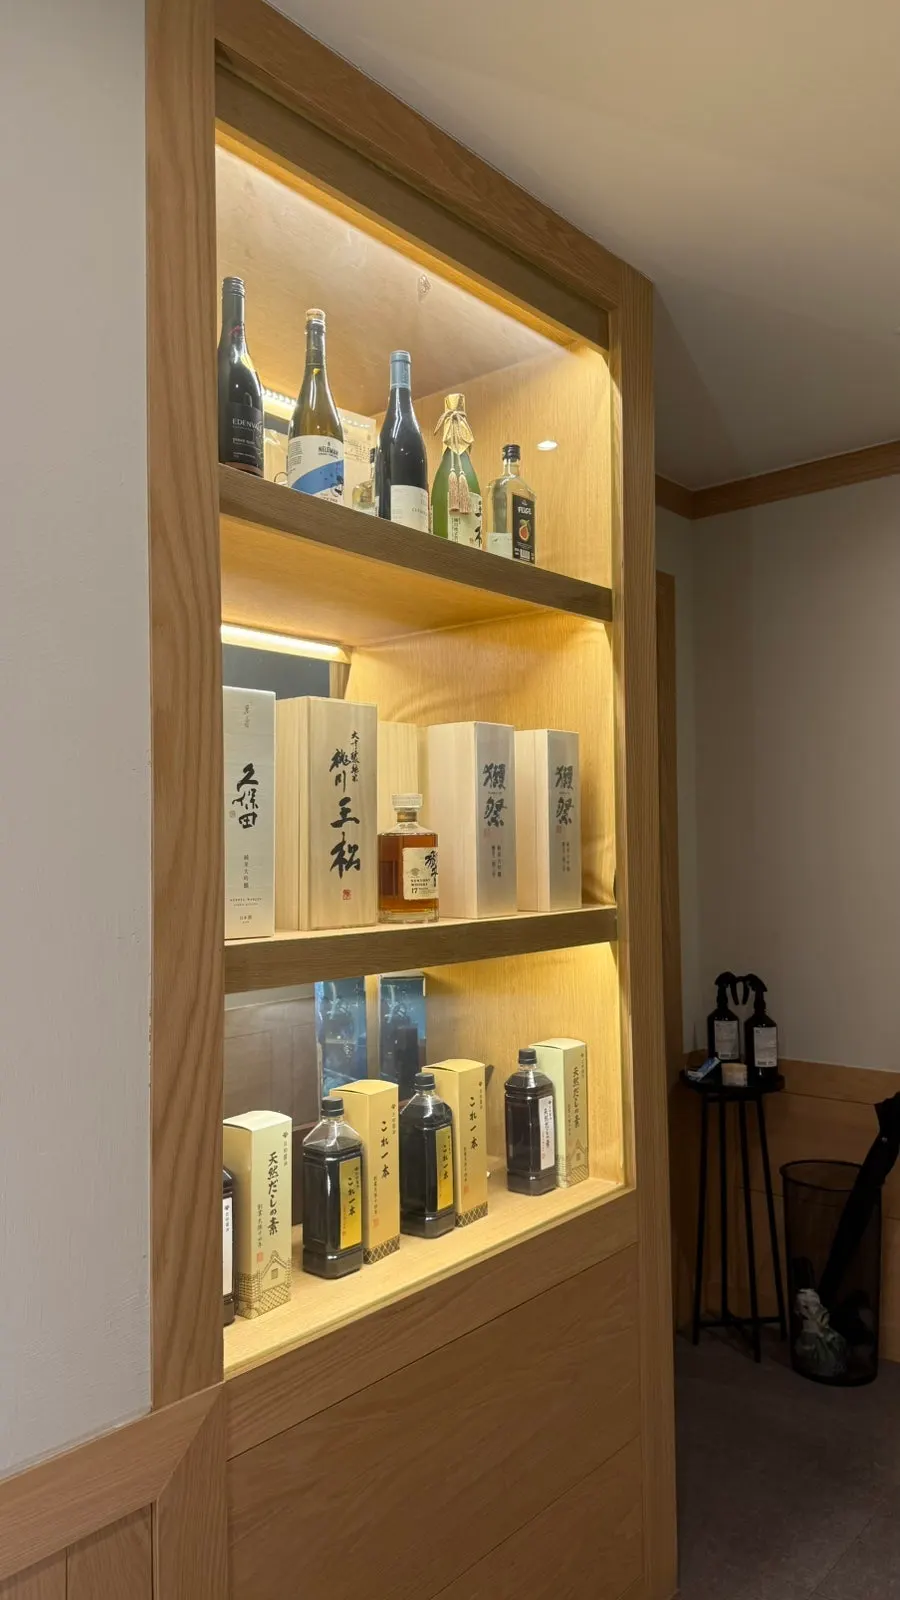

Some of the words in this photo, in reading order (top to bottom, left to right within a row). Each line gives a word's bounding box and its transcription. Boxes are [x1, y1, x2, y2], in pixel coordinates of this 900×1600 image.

[231, 762, 259, 829] 久保田
[482, 762, 508, 828] 獺祭
[555, 764, 575, 825] 獺祭
[380, 1120, 390, 1179] これ一本
[469, 1096, 478, 1150] これ一本
[267, 1151, 279, 1236] 天然だしの素
[347, 1177, 356, 1216] これ一本
